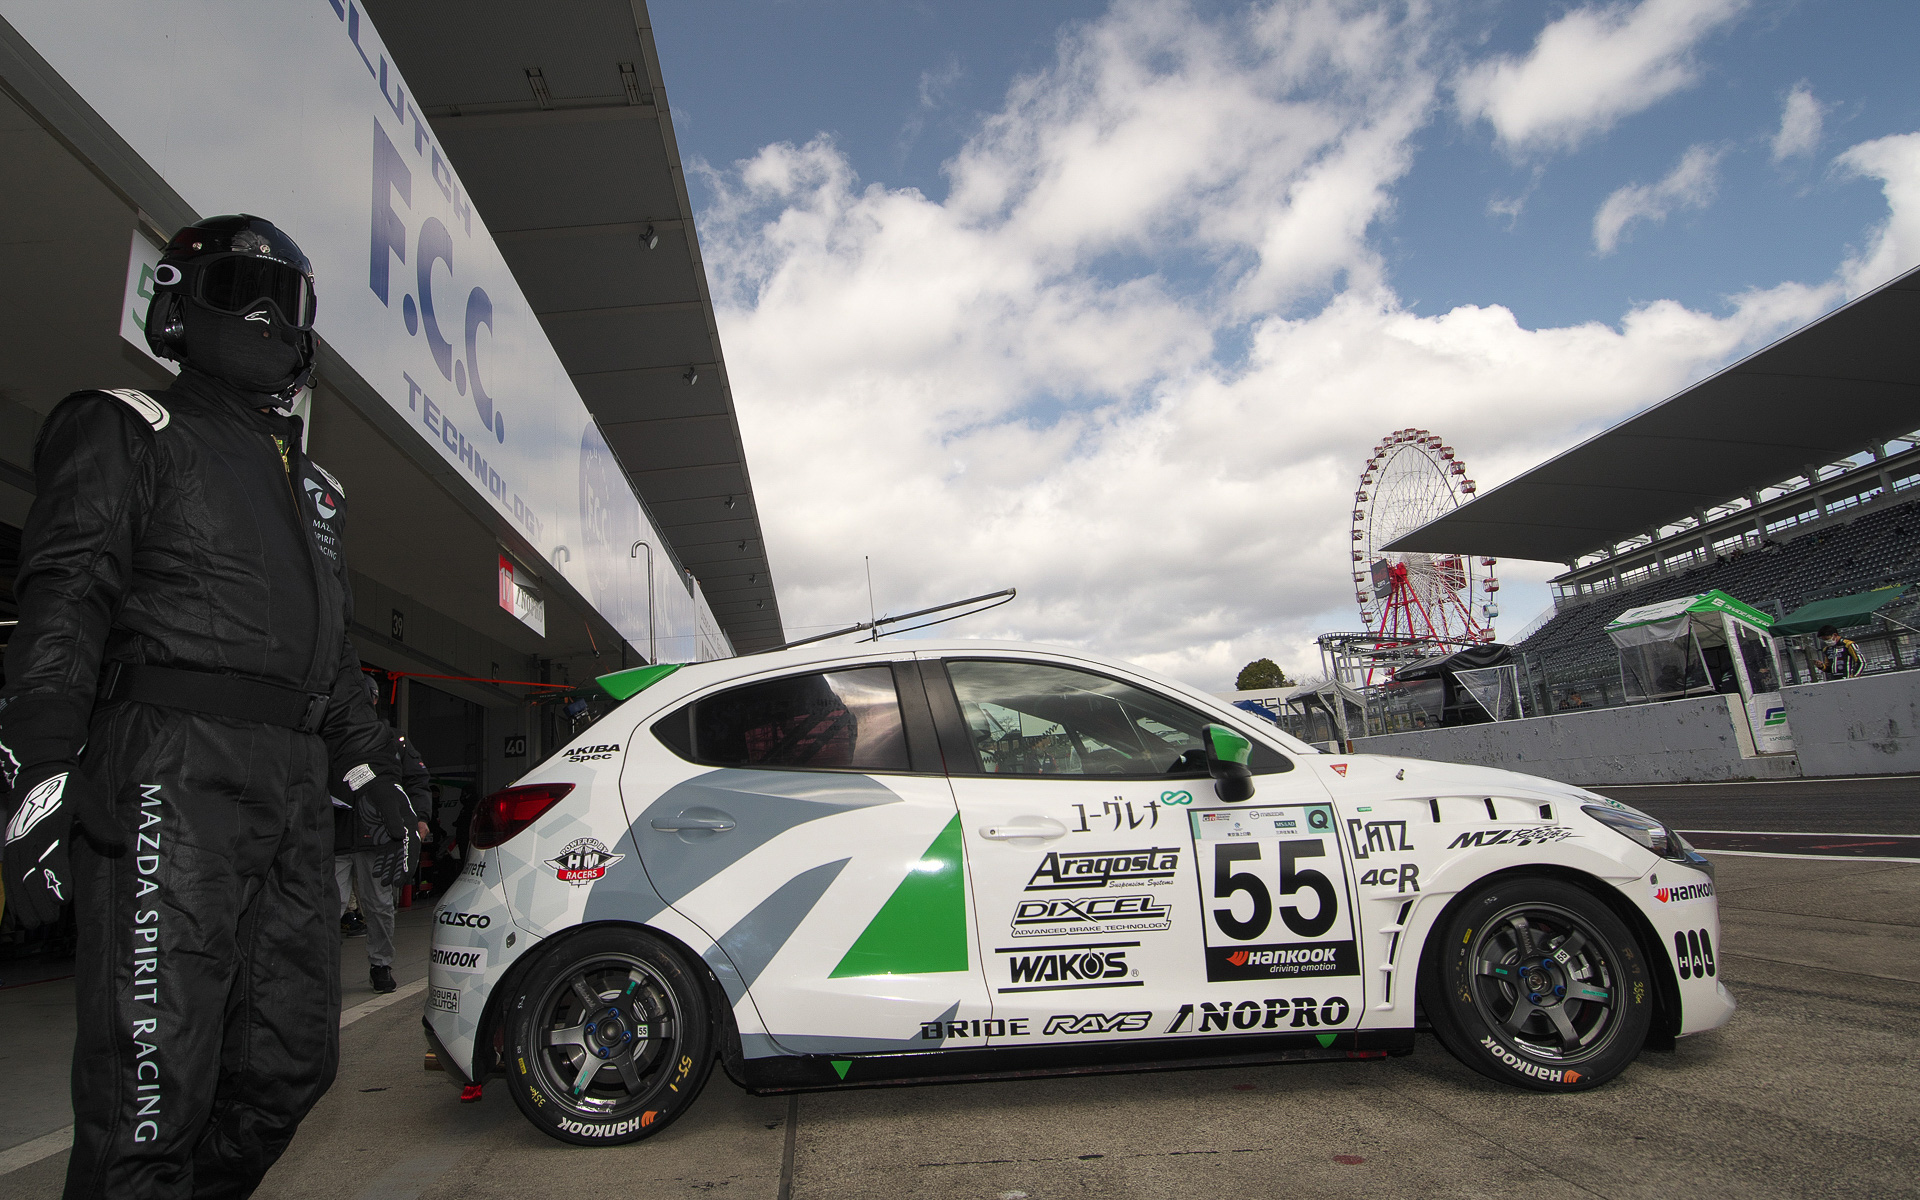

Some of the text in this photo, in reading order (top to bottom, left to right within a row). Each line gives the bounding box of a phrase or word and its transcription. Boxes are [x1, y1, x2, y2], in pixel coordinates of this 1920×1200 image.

[369, 115, 505, 444] F.C.C.
[403, 370, 545, 543] TECHNOLOGY
[318, 544, 338, 561] ACING
[500, 567, 513, 603] 17
[393, 614, 403, 637] 39
[505, 739, 526, 755] 40
[562, 744, 621, 757] AKIBA
[568, 753, 613, 763] Spec
[1071, 795, 1162, 833] ユーグレナ
[1308, 809, 1329, 829] Q
[560, 838, 609, 856] POWERED BY
[1346, 818, 1415, 860] CATZ
[565, 869, 598, 880] RACERS
[1027, 846, 1178, 889] Aragosta
[1360, 863, 1420, 893] 4CR
[1108, 878, 1174, 889] Suspension Systems
[1213, 839, 1338, 941] 55
[439, 911, 491, 929] CUSCO
[1016, 897, 1165, 923] DIXCEL
[1014, 928, 1067, 936] ADVANCED
[1105, 922, 1169, 931] TECHNOLOGY
[132, 783, 163, 1142] MAZDA SPIRIT RACING
[1556, 951, 1568, 962] 55
[1009, 951, 1129, 984] WAKO'S
[1269, 963, 1337, 974] driving emotion
[638, 1026, 648, 1036] 55
[919, 1010, 1153, 1040] BRIDE RAYS
